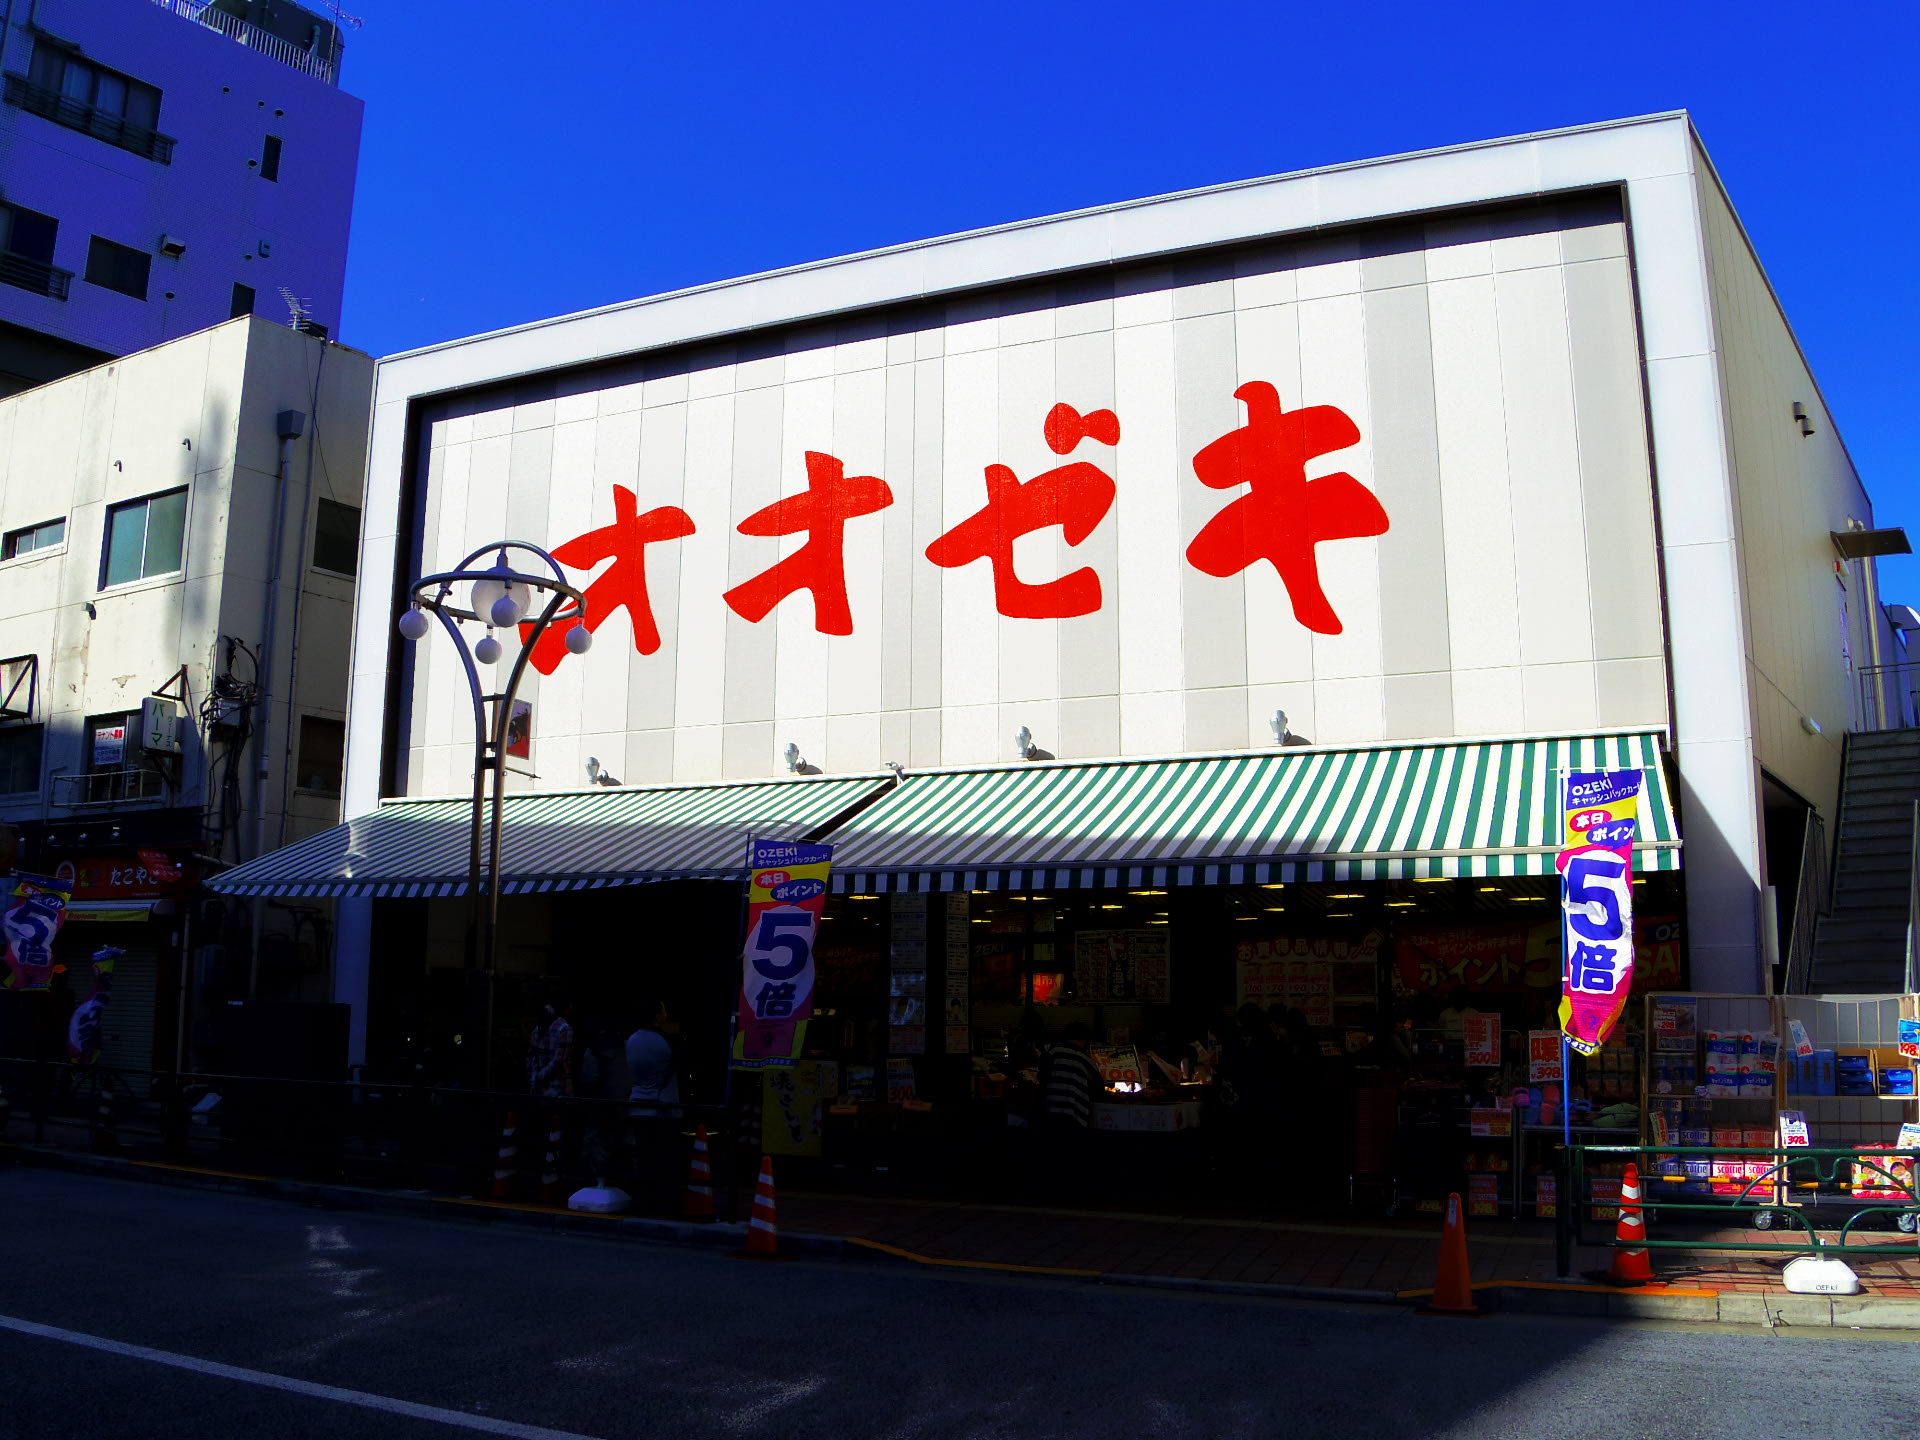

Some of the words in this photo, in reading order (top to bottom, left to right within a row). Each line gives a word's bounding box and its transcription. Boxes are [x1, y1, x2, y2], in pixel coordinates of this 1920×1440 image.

[520, 380, 1391, 674] オオゼキ
[1571, 778, 1613, 796] OZEKI
[1575, 812, 1604, 828] 本日
[1592, 825, 1635, 841] ポイン
[757, 847, 798, 858] OZEKI
[757, 852, 829, 866] キャッシュバックカード
[760, 873, 785, 886] 本日
[776, 882, 822, 899] ポイント
[1565, 857, 1626, 941] 5
[752, 912, 813, 981] 5
[1571, 941, 1616, 992] 倍
[756, 982, 796, 1017] 倍
[1682, 1131, 1707, 1140] scottie
[1682, 1164, 1707, 1173] scottie
[1717, 1165, 1742, 1174] scottie
[1748, 1165, 1772, 1174] scotti
